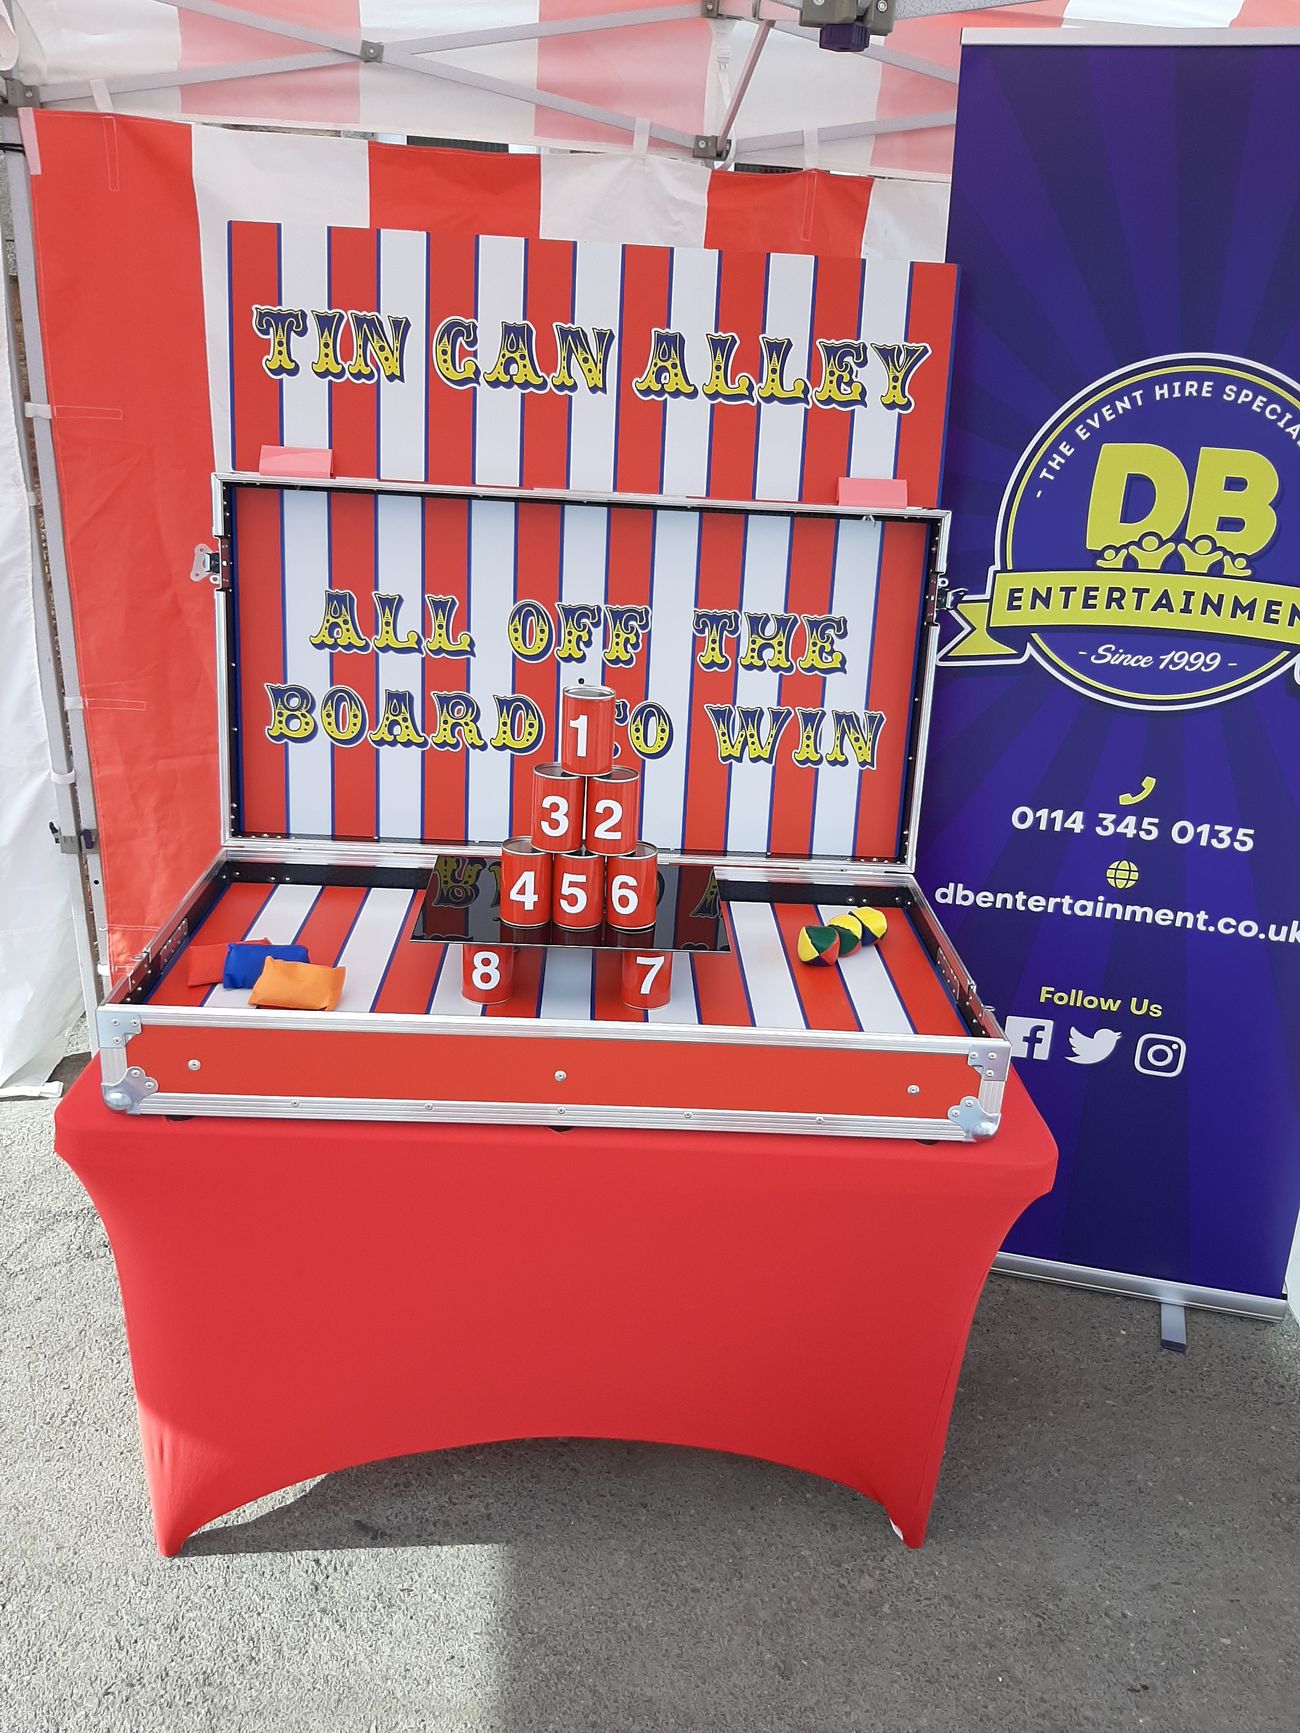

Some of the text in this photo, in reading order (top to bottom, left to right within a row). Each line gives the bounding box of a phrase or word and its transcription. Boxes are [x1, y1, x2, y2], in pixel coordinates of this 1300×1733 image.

[252, 305, 931, 413] TIN CAN ALLEY
[1039, 380, 1300, 481] THE EVENT HIRE SPECIA
[1086, 442, 1279, 557] DB
[309, 588, 848, 675] ALL OFF THE
[1090, 643, 1222, 673] Since 1999
[264, 682, 887, 770] BOARD O WIN
[569, 714, 588, 758] 1
[540, 795, 570, 838] 3
[594, 799, 624, 840] 2
[1011, 806, 1256, 852] 0114 345 0135
[509, 871, 539, 911] 4
[559, 873, 588, 914] 5
[611, 875, 639, 916] 6
[934, 882, 1300, 944] dbentertainment.co.uk
[471, 951, 501, 991] 8
[636, 956, 666, 995] 7
[1039, 986, 1164, 1019] Follow Us
